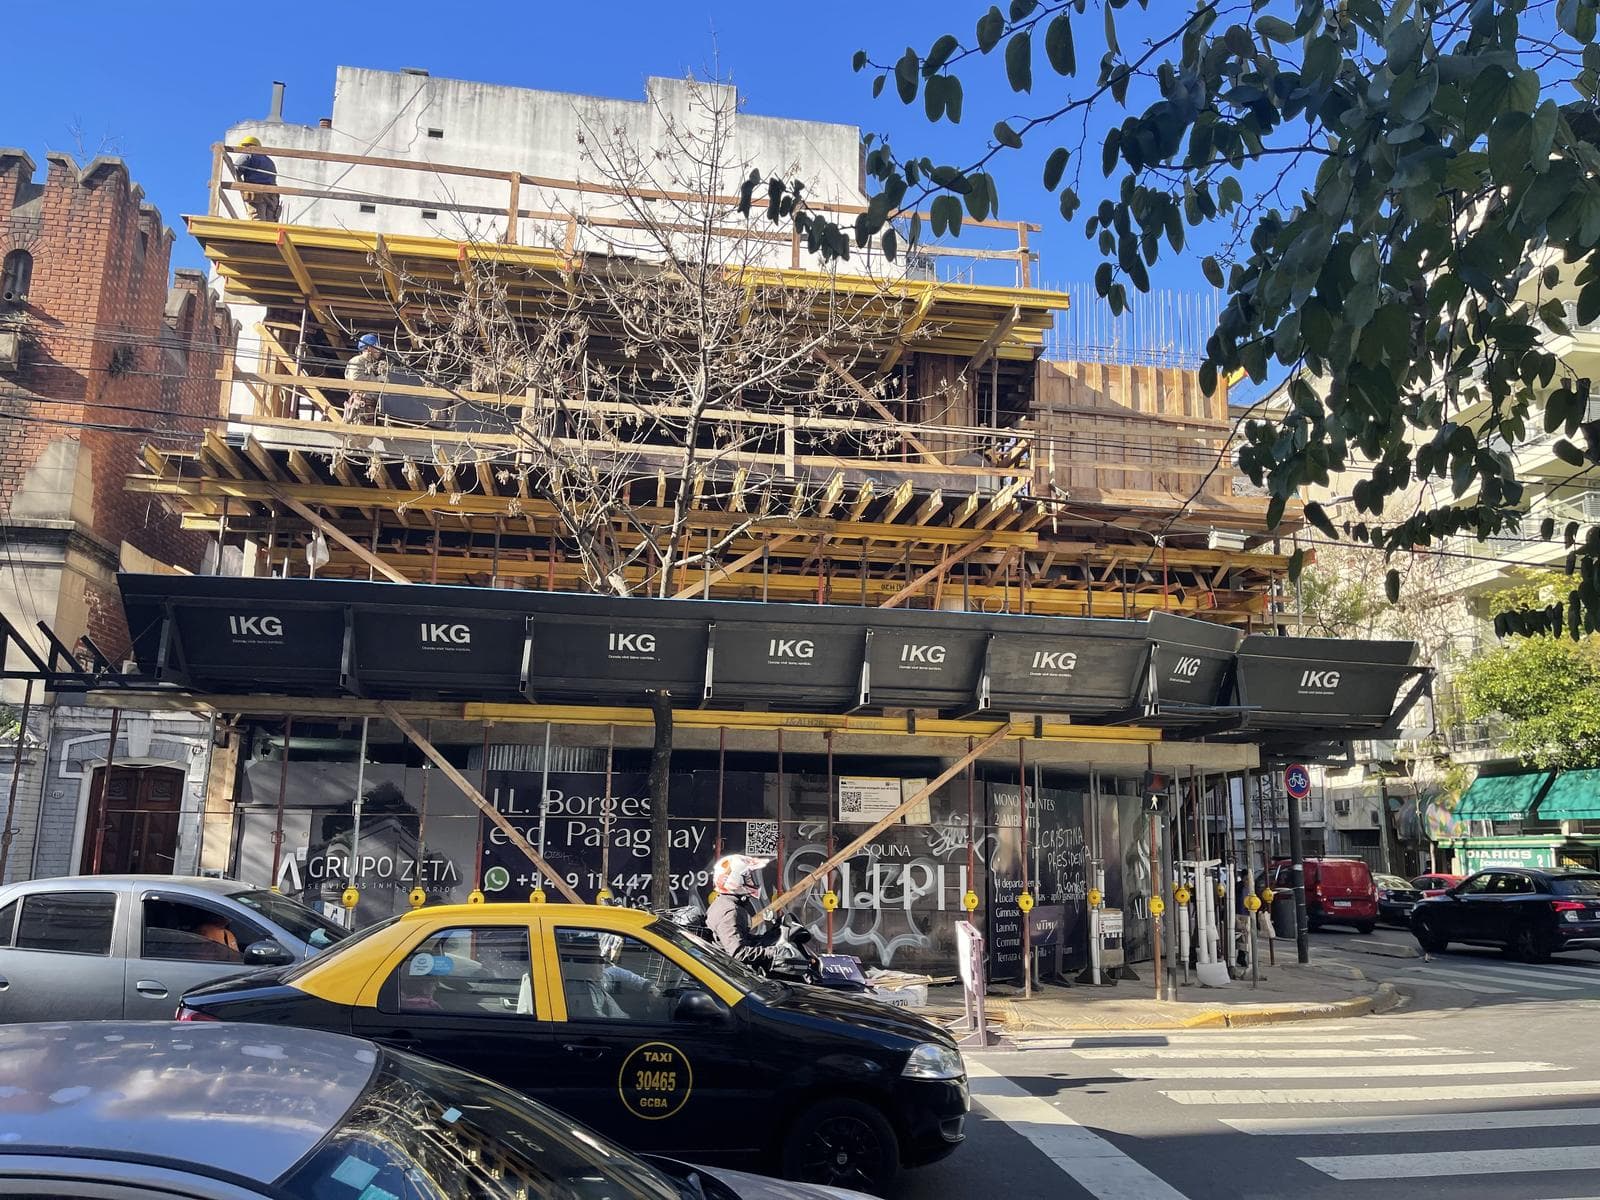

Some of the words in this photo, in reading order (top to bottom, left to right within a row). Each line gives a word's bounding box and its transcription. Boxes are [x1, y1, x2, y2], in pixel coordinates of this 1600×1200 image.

[229, 615, 283, 636] IKG
[421, 623, 471, 643] IKG
[609, 633, 656, 653] IKG
[768, 639, 814, 658] IKG
[900, 644, 946, 663] IKG
[1032, 651, 1077, 670] IKG
[1173, 656, 1201, 677] IKG
[1300, 670, 1341, 688] IKG
[545, 789, 651, 825] Borges
[567, 821, 706, 858] Paragay
[856, 843, 911, 860] ESQUINA
[1466, 850, 1532, 860] DIARIOS
[309, 855, 393, 878] GRUPO
[401, 860, 457, 881] ZETA
[308, 882, 366, 891] SERVICOS
[567, 872, 579, 889] 9
[586, 873, 602, 889] 11
[996, 921, 1017, 933] Laundry
[643, 1052, 673, 1063] TAXI
[636, 1070, 676, 1092] 30465
[640, 1097, 668, 1108] GCBA
